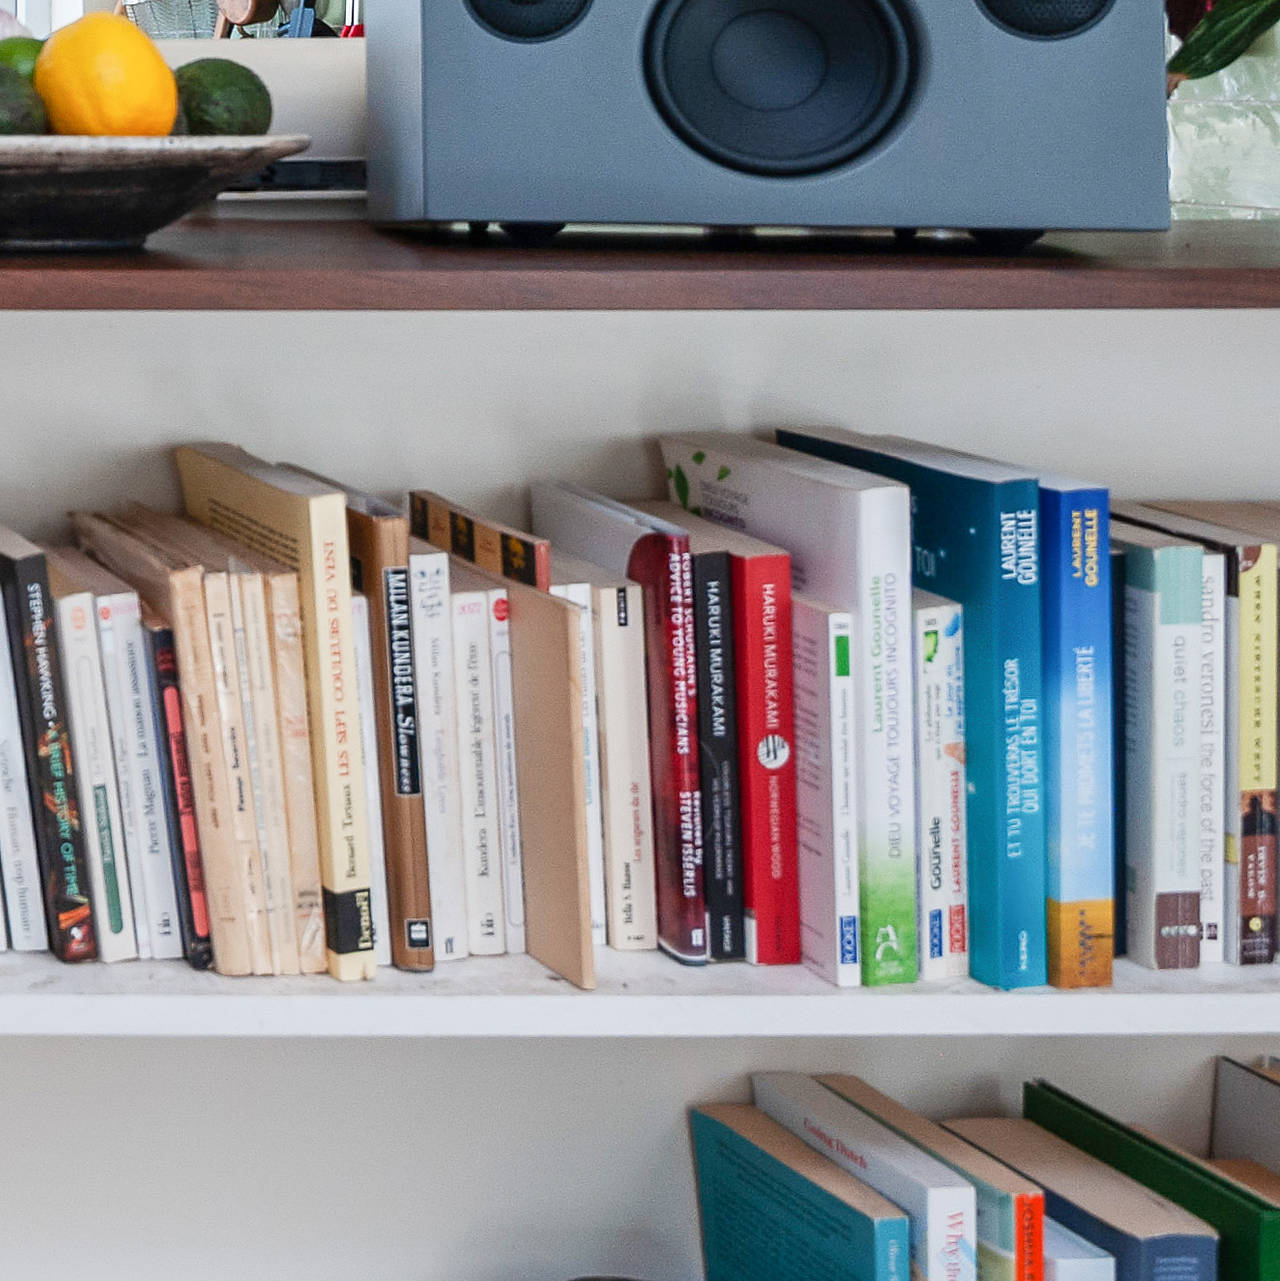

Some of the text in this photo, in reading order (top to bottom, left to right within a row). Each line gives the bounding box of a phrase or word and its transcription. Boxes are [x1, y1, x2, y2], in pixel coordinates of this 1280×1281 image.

[681, 552, 692, 603] ROBERT
[1000, 512, 1017, 580] LAURENT
[1017, 509, 1037, 585] GOUNELLE
[1072, 510, 1083, 578] LAURENT
[1085, 508, 1098, 586] GOUNELLE
[1253, 575, 1262, 624] WHEN
[27, 582, 57, 720] STEPHEN HAWKING
[323, 539, 350, 776] LES SEPT COULEURS DU VENT
[388, 572, 415, 792] MILAN KUNDERA Slowness
[668, 552, 690, 755] ADVICE TO YOUNG MUSICIANS
[706, 580, 726, 737] HARUKI MURAKAMI
[762, 583, 780, 730] HARUKI MURAKAMI
[868, 575, 883, 734] Laurent Gounelle
[1173, 635, 1189, 747] quiet chaos
[883, 573, 902, 858] DIEU VOYAGE TOUJOURS INCOGNITO
[1019, 698, 1039, 814] QUI DORT EN TOI
[1072, 646, 1095, 849] JE TE PROMETS LA LIBERTÉ
[1199, 575, 1219, 902] sandro veronesi the force of the past
[49, 741, 63, 778] BRIEF
[1002, 658, 1021, 858] ET TU TROUVERAS LE TRÉSOR
[1253, 736, 1262, 782] WEPT
[53, 781, 71, 840] HISTORY
[141, 768, 160, 854] Pierre Magnan
[679, 790, 697, 897] STEVEN ISSERLIS
[768, 774, 782, 880] NORWEGIAN WOOD
[950, 770, 961, 894] LAURENT GOUNELLE
[60, 841, 75, 863] OF
[65, 862, 80, 896] TIME
[344, 835, 356, 878] Bernard
[476, 828, 489, 878] Kundera
[693, 848, 703, 865] by
[929, 817, 943, 891] Gounelle
[939, 1211, 965, 1259] Why
[1022, 1202, 1035, 1266] JOSHUA
